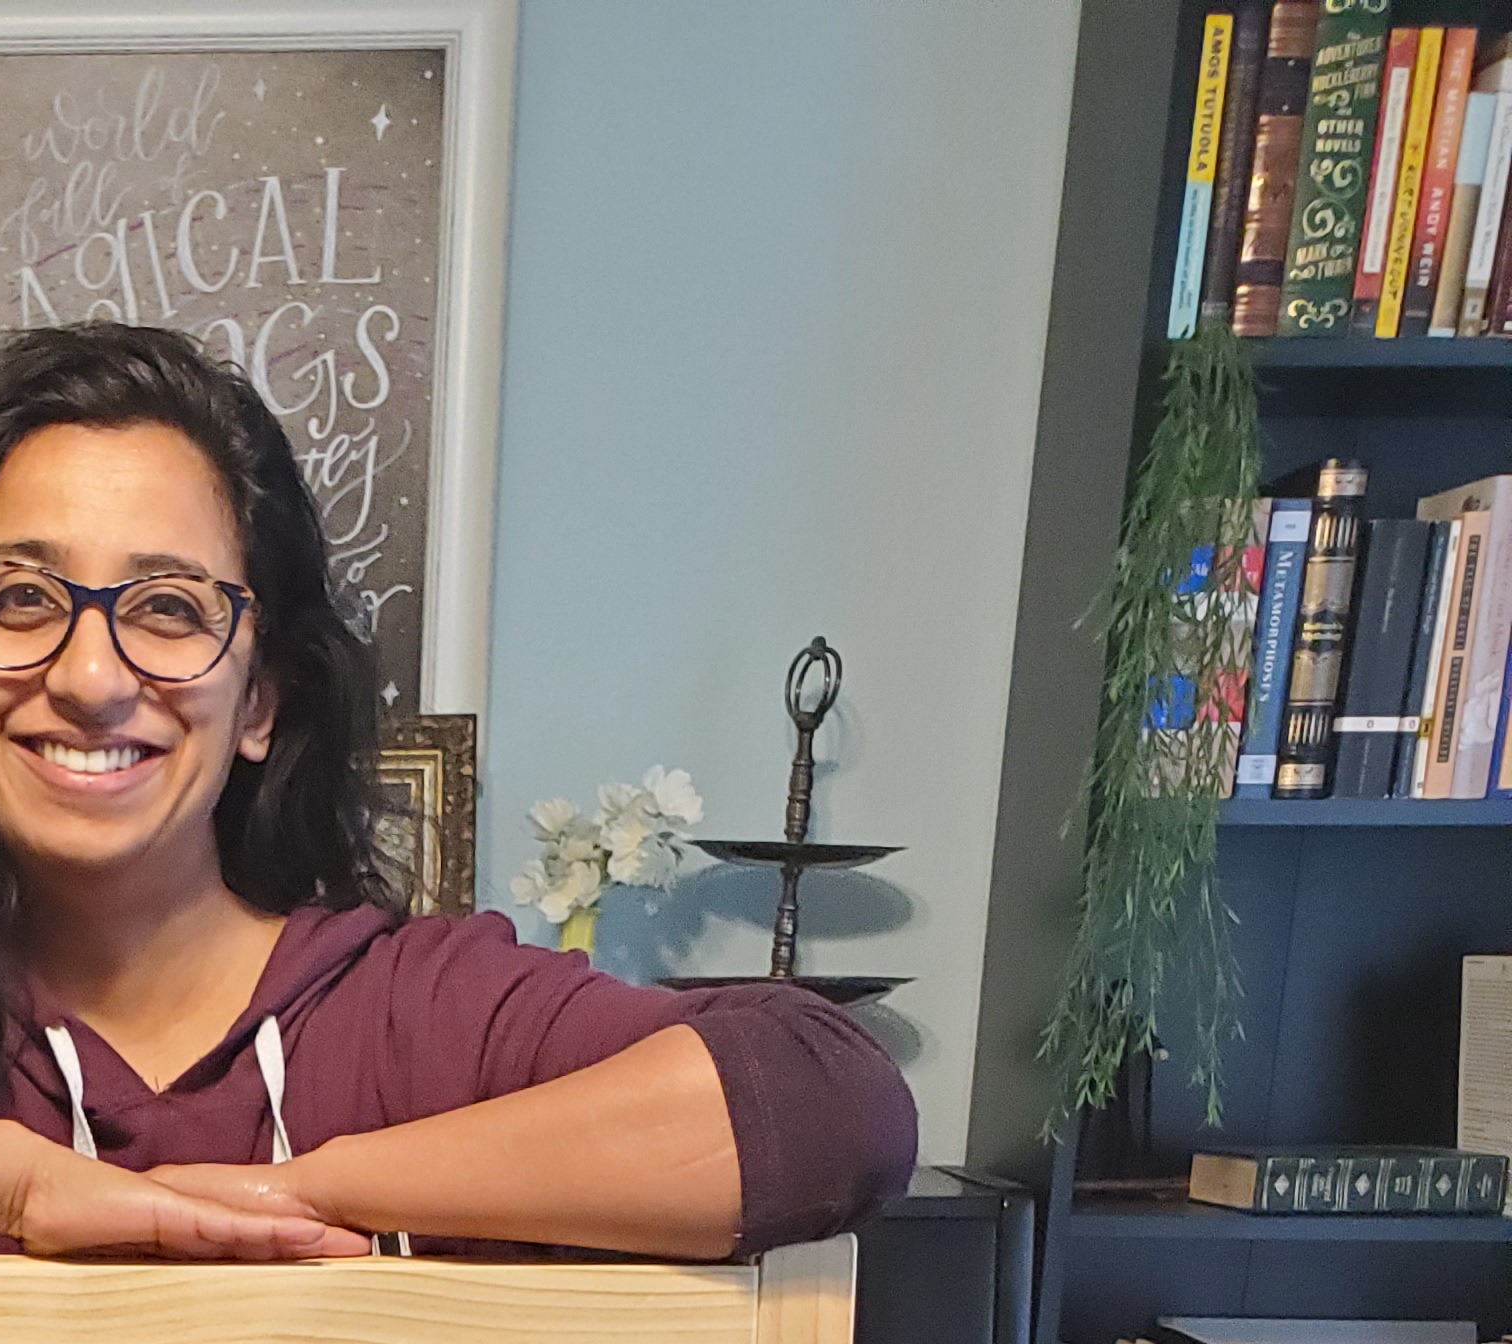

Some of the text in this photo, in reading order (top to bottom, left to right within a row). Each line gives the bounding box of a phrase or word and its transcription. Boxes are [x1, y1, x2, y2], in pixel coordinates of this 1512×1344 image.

[1196, 27, 1225, 173] AMOS TUTUOLA
[1315, 138, 1362, 153] NOVELS
[1317, 118, 1365, 137] OTHER
[1417, 48, 1467, 287] THE MARTIAN ANDY WEIR
[1259, 550, 1295, 703] METAMORPHOSES
